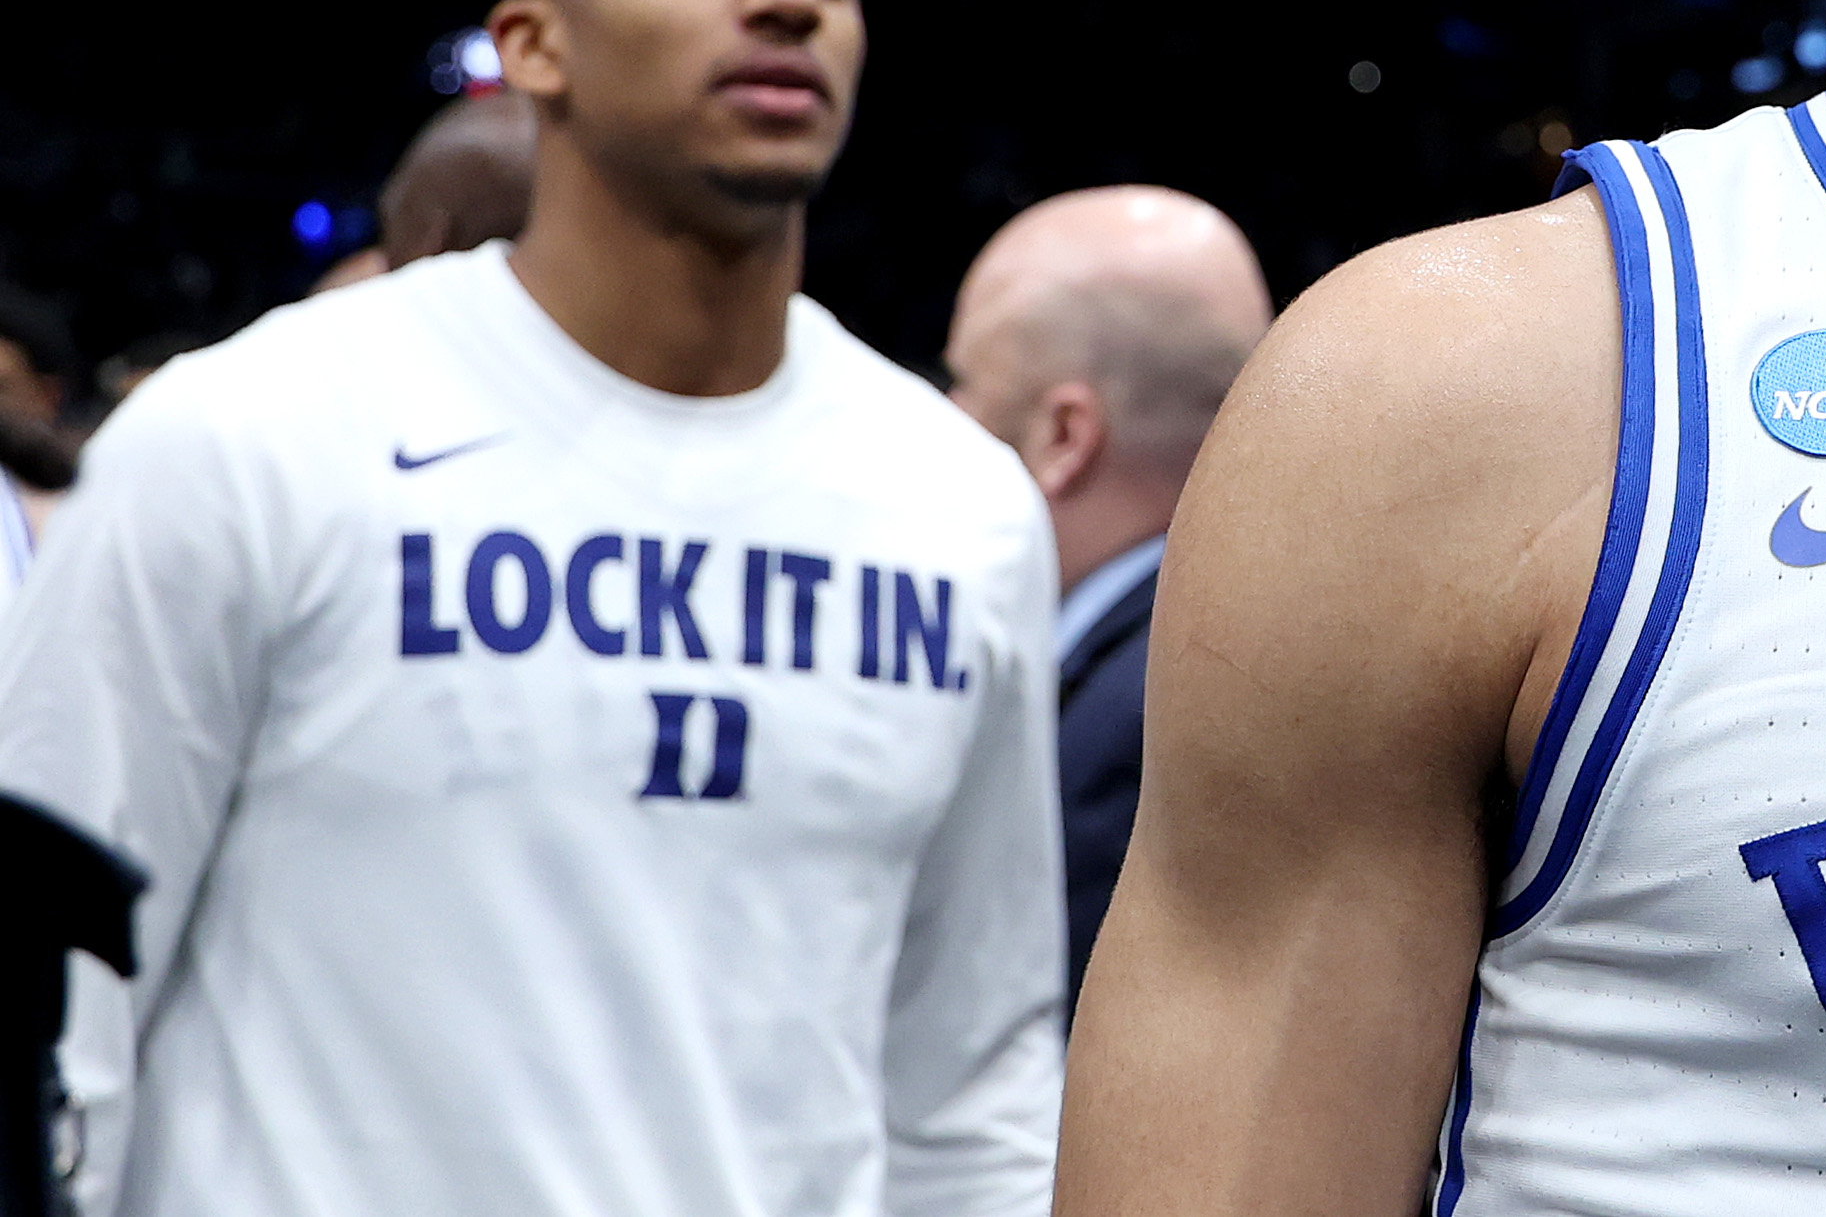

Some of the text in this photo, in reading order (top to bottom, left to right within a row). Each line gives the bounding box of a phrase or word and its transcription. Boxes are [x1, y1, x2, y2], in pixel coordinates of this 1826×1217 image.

[400, 531, 968, 691] LOCK IT IN.
